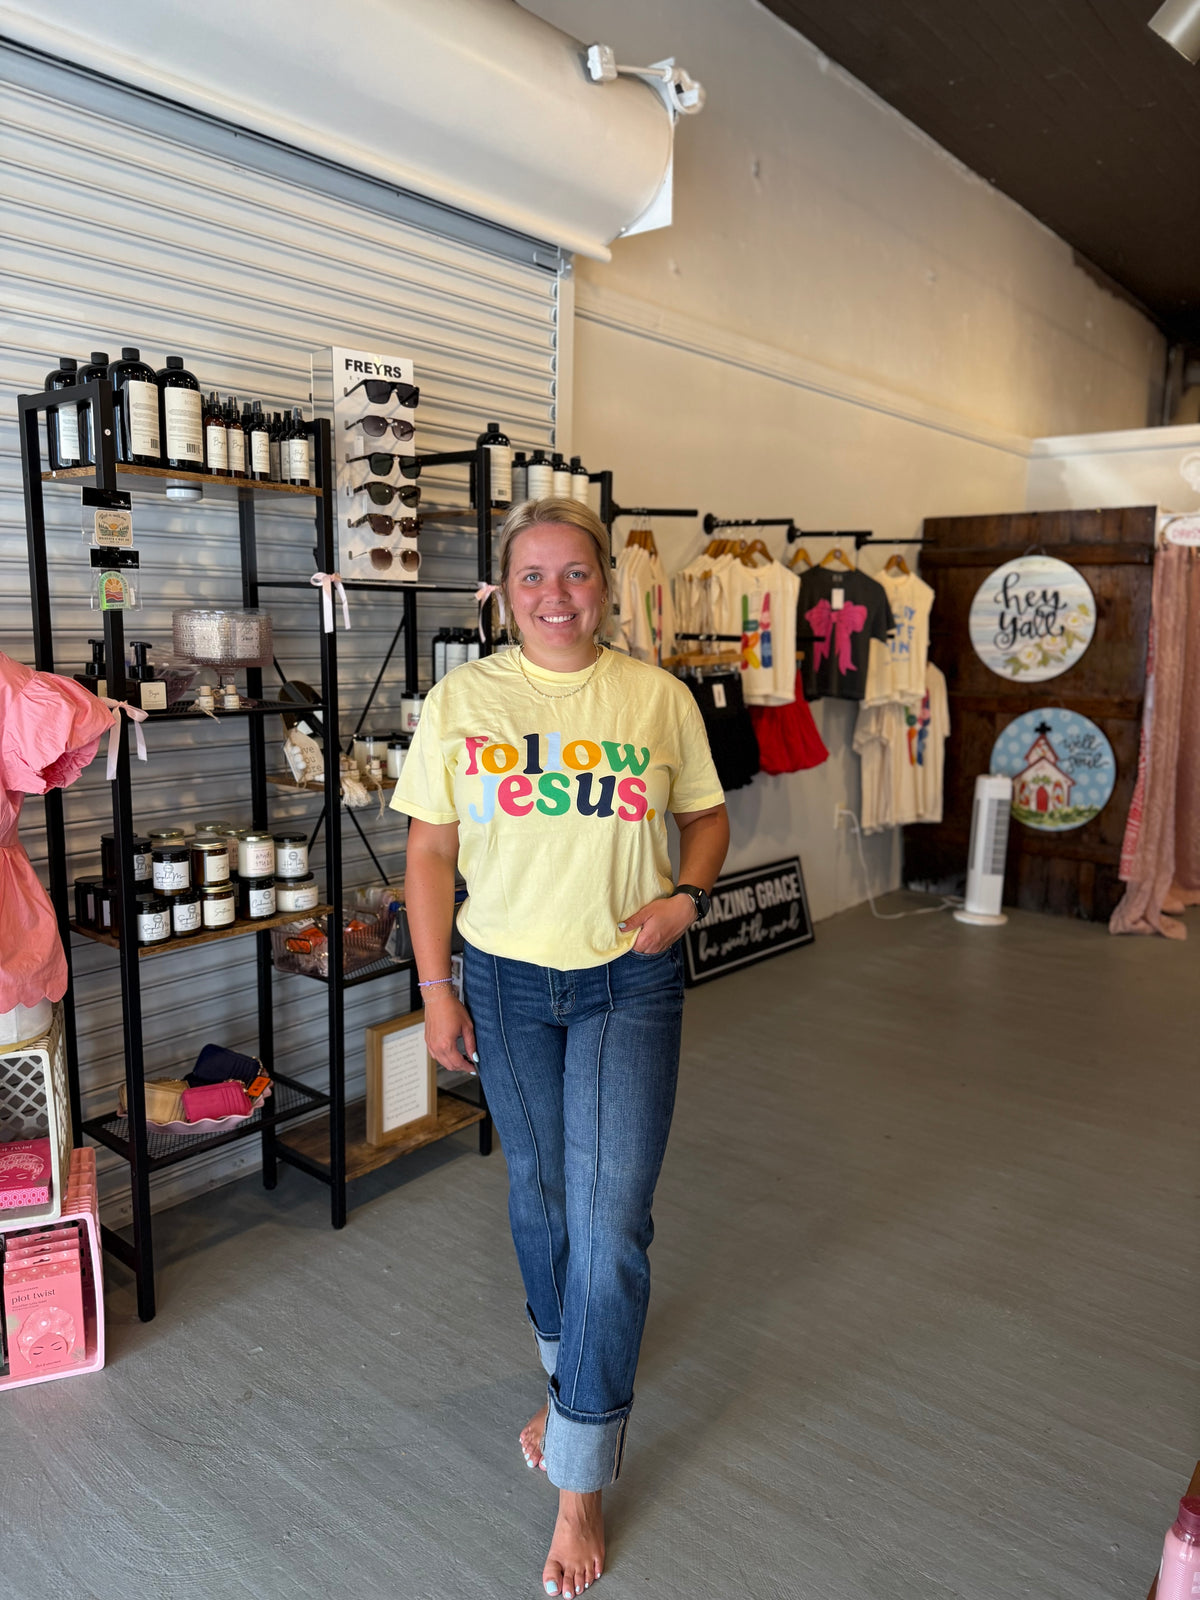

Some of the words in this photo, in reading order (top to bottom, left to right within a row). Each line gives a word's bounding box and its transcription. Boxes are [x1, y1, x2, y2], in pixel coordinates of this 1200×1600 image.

[345, 358, 402, 379] FREYRS
[994, 572, 1067, 616] hey
[468, 772, 656, 824] Jesus.
[755, 873, 801, 910] GRACE
[11, 1294, 31, 1306] plot
[33, 1289, 56, 1300] twist
